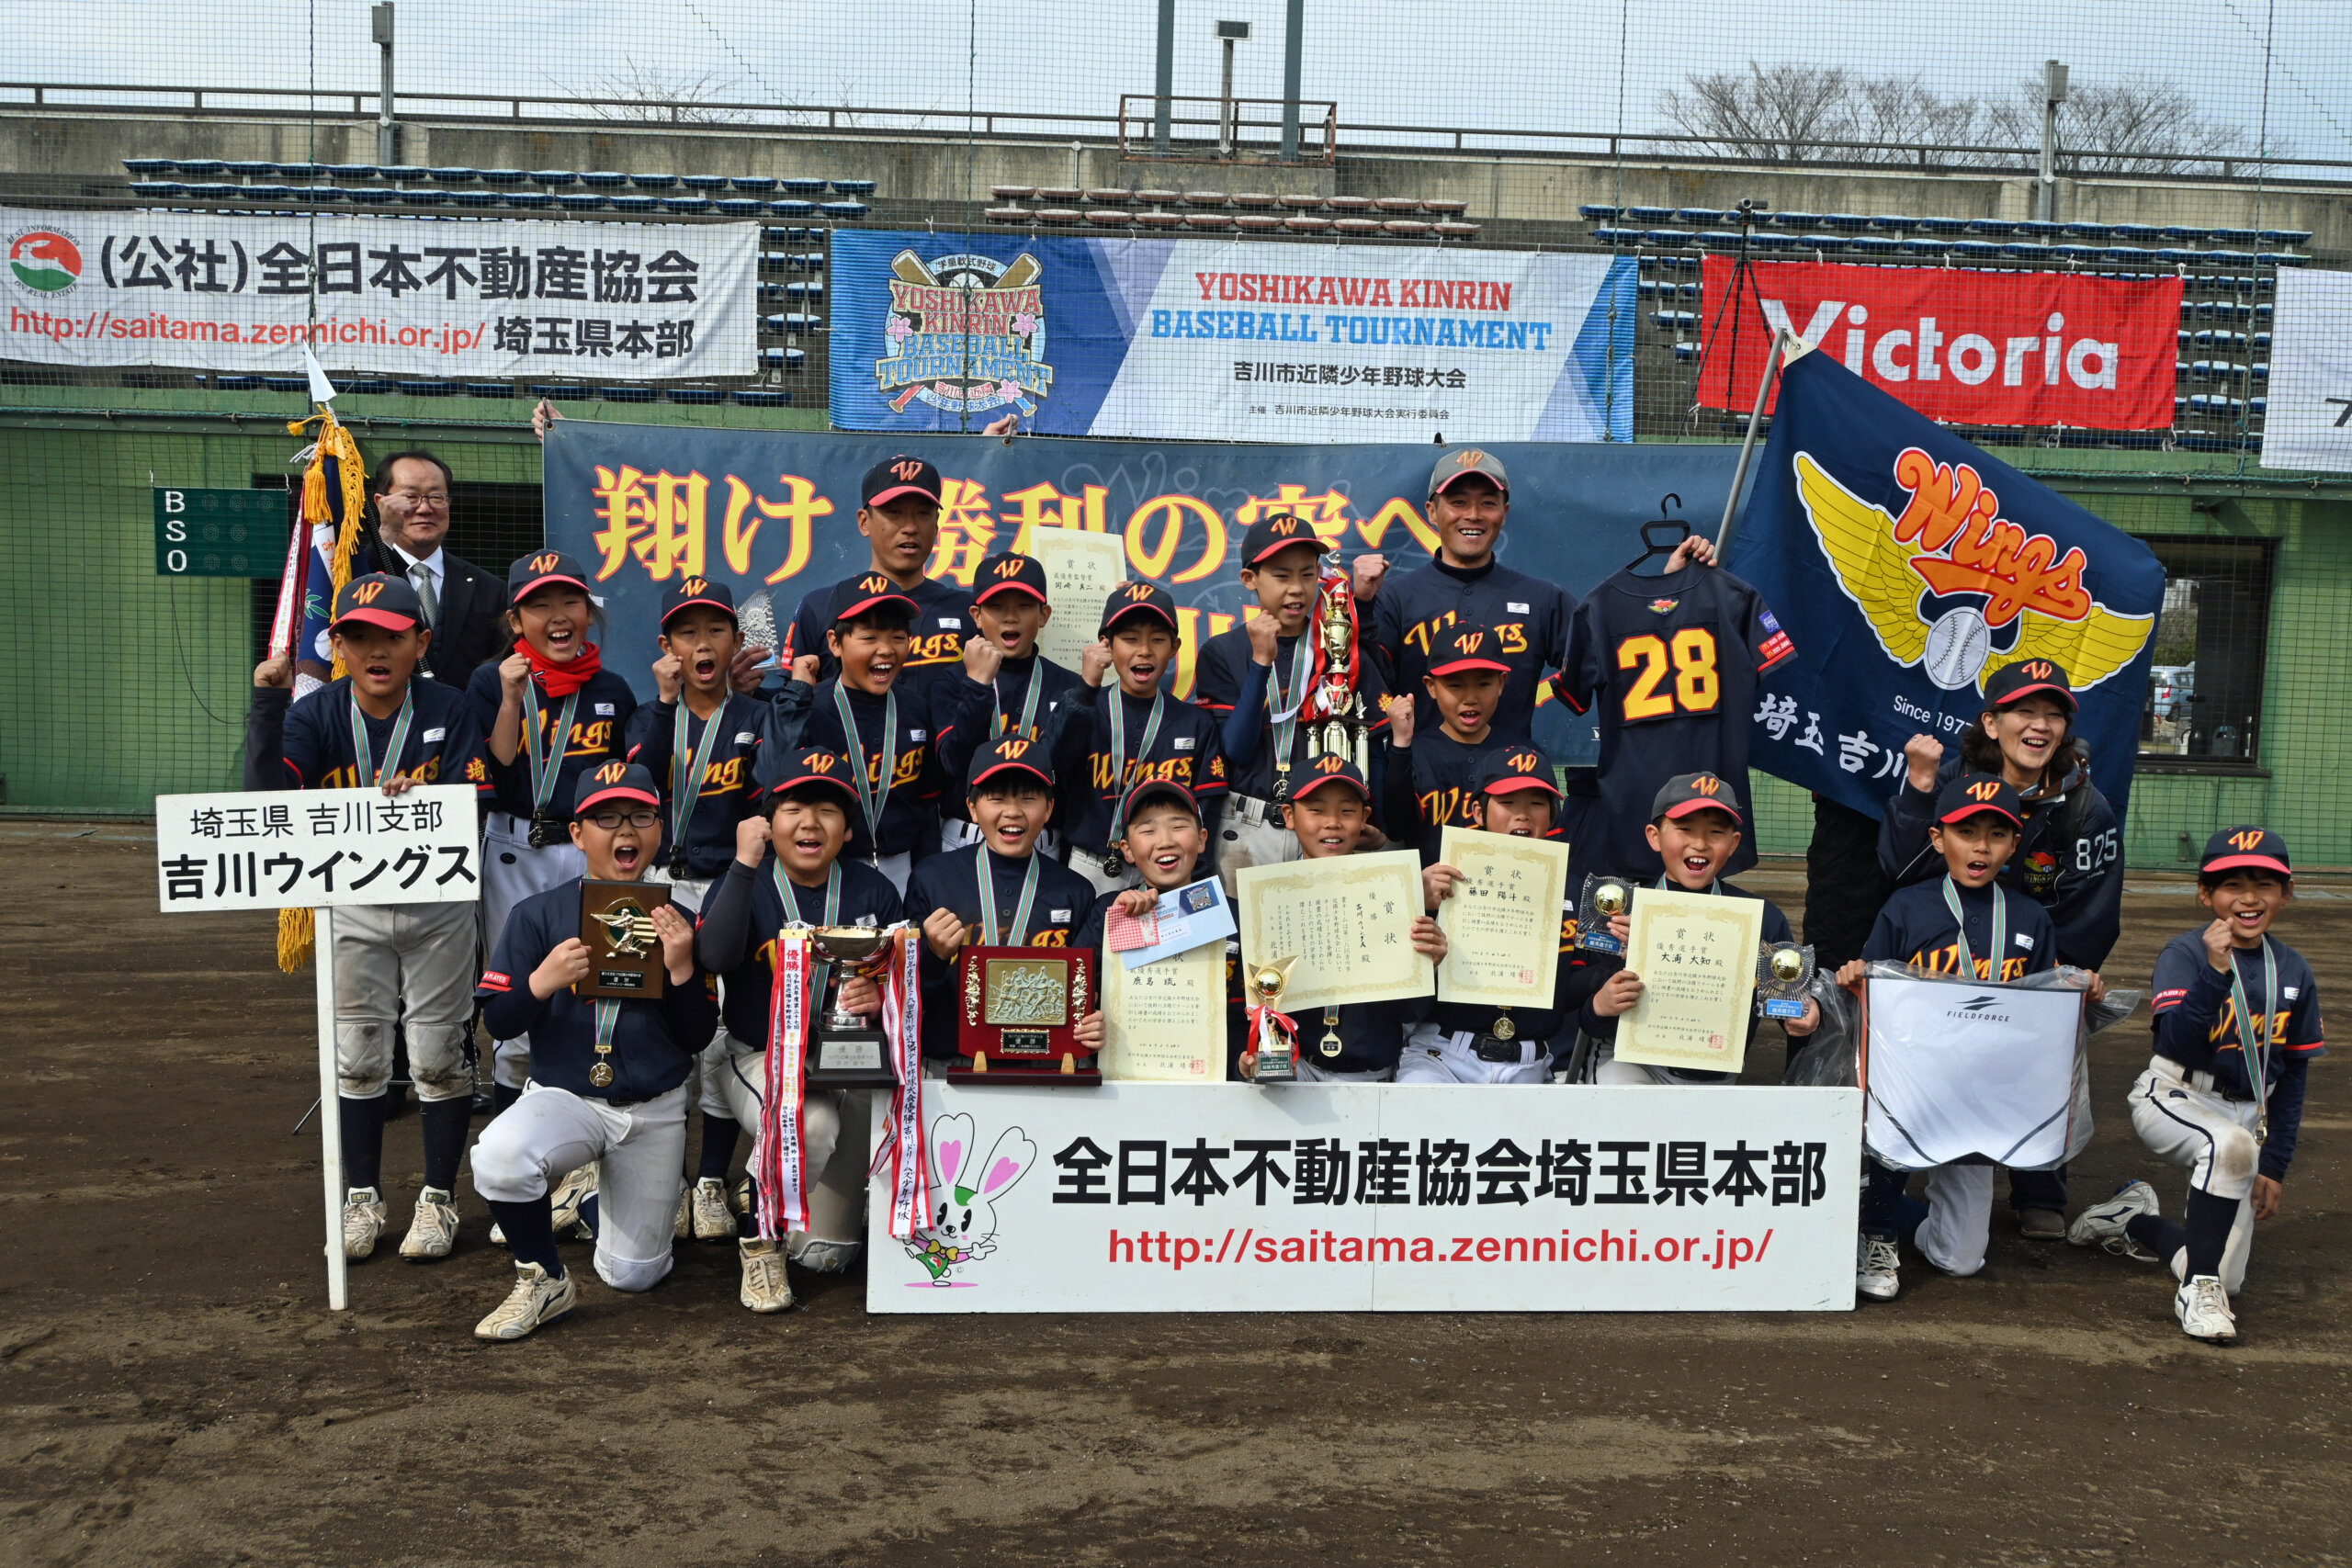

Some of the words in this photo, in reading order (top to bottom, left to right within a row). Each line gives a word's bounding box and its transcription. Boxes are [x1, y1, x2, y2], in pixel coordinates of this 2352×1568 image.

[101, 234, 700, 305] (公社)全日本不動産協会
[893, 283, 1040, 313] YOSHIKAWA
[1194, 273, 1395, 309] YOSHIKAWA
[1397, 279, 1512, 311] KINRIN
[10, 306, 485, 355] http://saitama.zennichi.or.jp/
[493, 316, 695, 359] 埼玉県本部
[923, 311, 1008, 335] KINRIN
[1150, 310, 1317, 344] BASEBALL
[1327, 315, 1552, 351] TOURNAMENT
[903, 334, 1027, 362] BASEBALL
[1759, 299, 2120, 390] Victoria
[879, 355, 1052, 393] TOURNAMENT
[1234, 361, 1466, 389] 吉川市近隣少年野球大会
[165, 491, 186, 513] B
[165, 520, 187, 542] S
[592, 463, 834, 586] 翔け
[1893, 446, 2092, 627] Wings
[1616, 627, 1721, 722] 28
[1893, 694, 1931, 723] Since
[190, 805, 295, 840] 埼玉県
[306, 799, 444, 837] 吉川支部
[2076, 828, 2118, 871] 825
[161, 843, 478, 901] 吉川ウイングス
[786, 949, 800, 972] 優勝
[1947, 1010, 2011, 1022] FIELDFORCE
[1051, 1135, 1827, 1210] 全日本不動産協会埼玉県本部
[1107, 1227, 1773, 1271] http://saitama.zennichi.or.jp/
